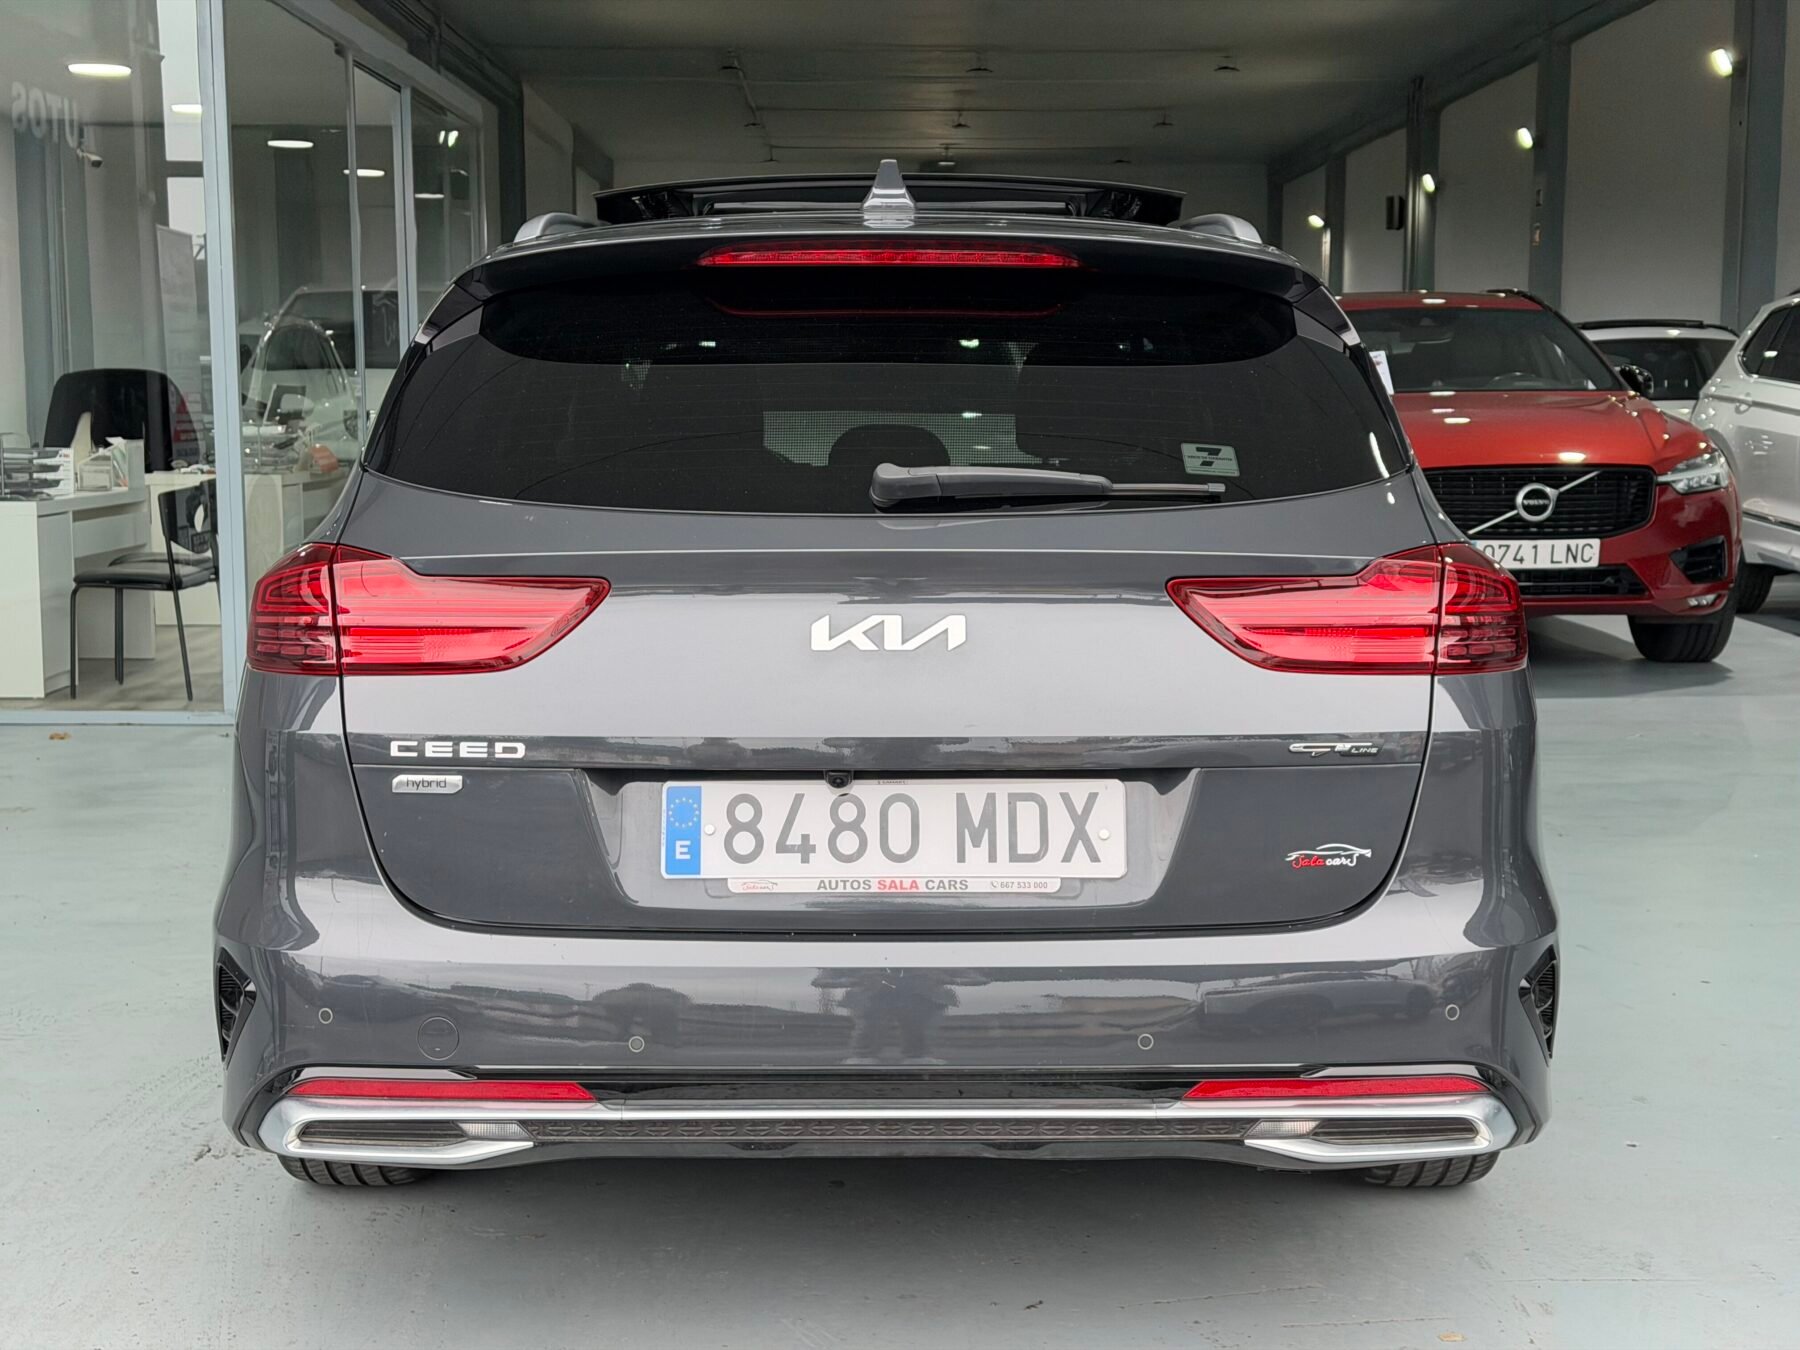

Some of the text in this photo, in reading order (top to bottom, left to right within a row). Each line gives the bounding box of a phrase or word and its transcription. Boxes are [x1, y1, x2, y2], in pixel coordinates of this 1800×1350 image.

[1550, 543, 1594, 564] LNC
[811, 614, 967, 651] KIA
[390, 740, 526, 758] CEED
[406, 777, 447, 790] hybrid
[723, 793, 921, 865] 8480
[955, 791, 1102, 864] MDX
[675, 840, 691, 860] E
[817, 879, 969, 891] AUTOS SALA CARS
